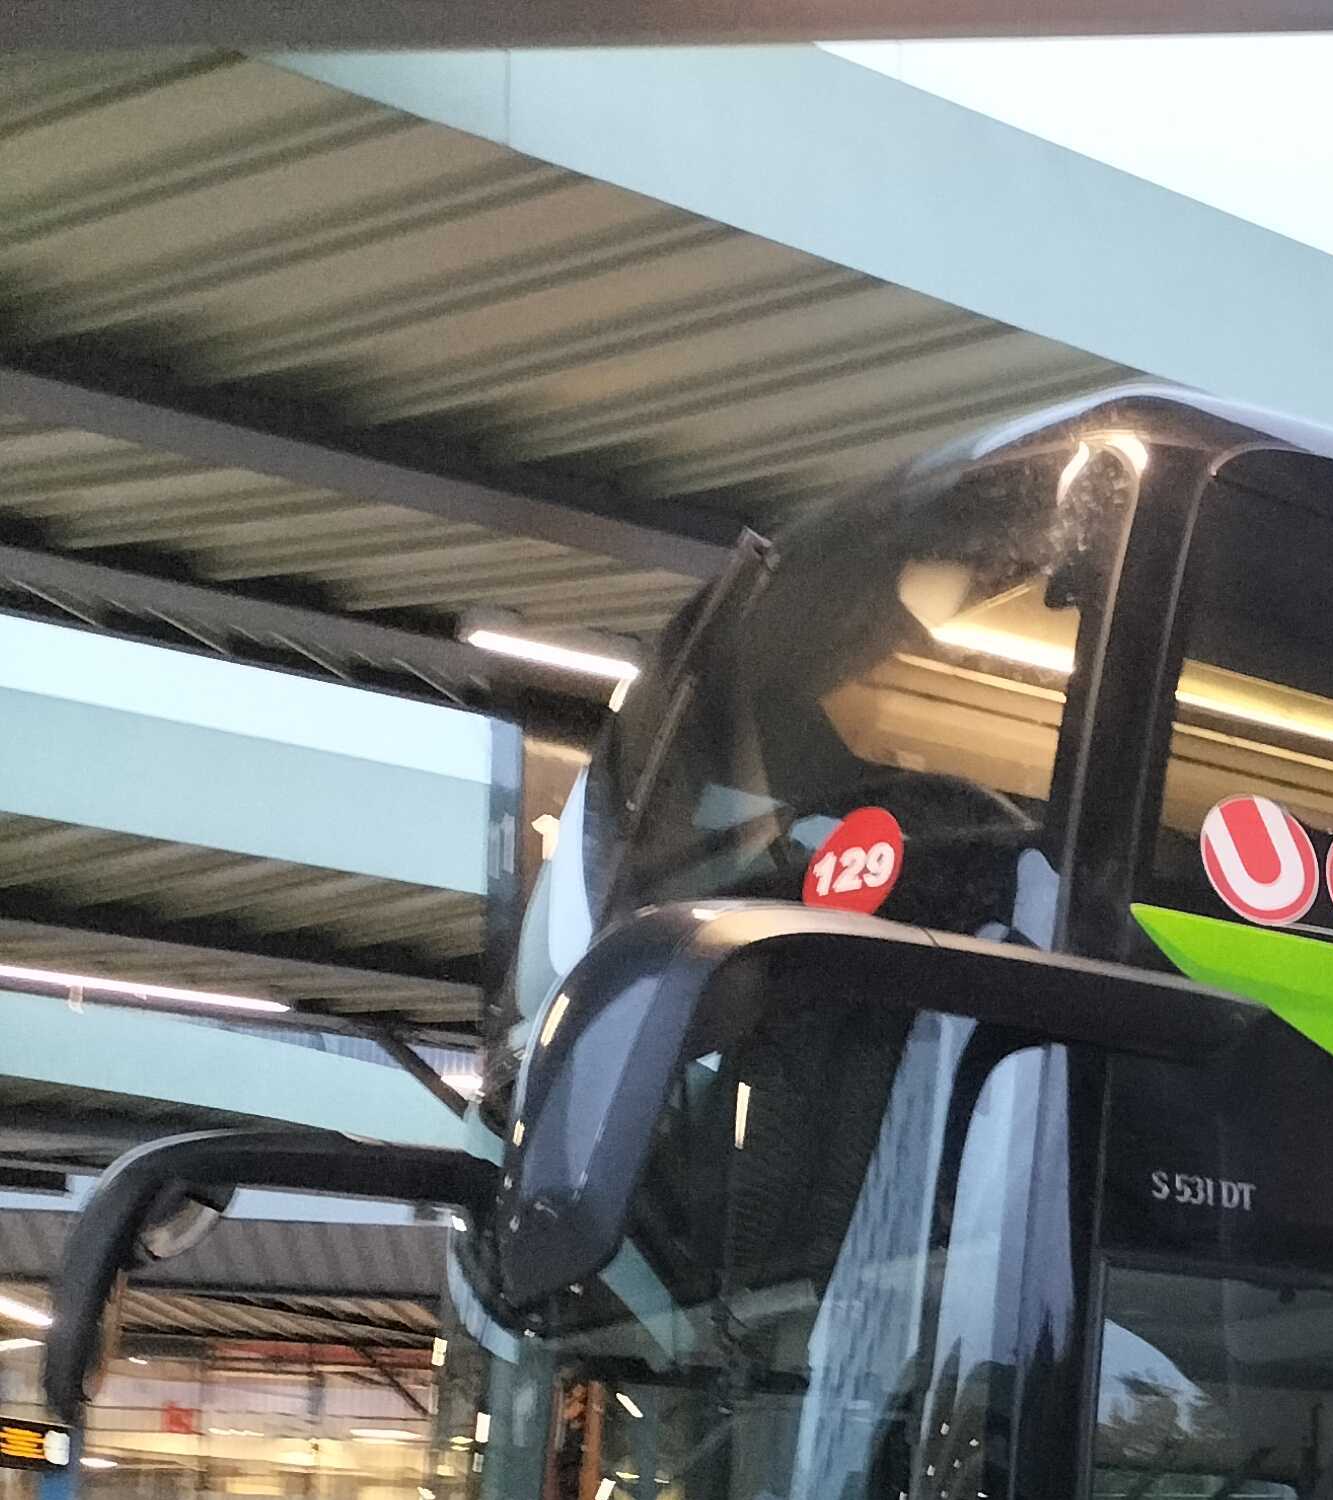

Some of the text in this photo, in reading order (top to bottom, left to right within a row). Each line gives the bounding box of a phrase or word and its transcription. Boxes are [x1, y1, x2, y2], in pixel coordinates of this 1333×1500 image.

[812, 841, 895, 897] 129
[1202, 795, 1305, 911] U
[1151, 1170, 1256, 1211] S 531 DT
